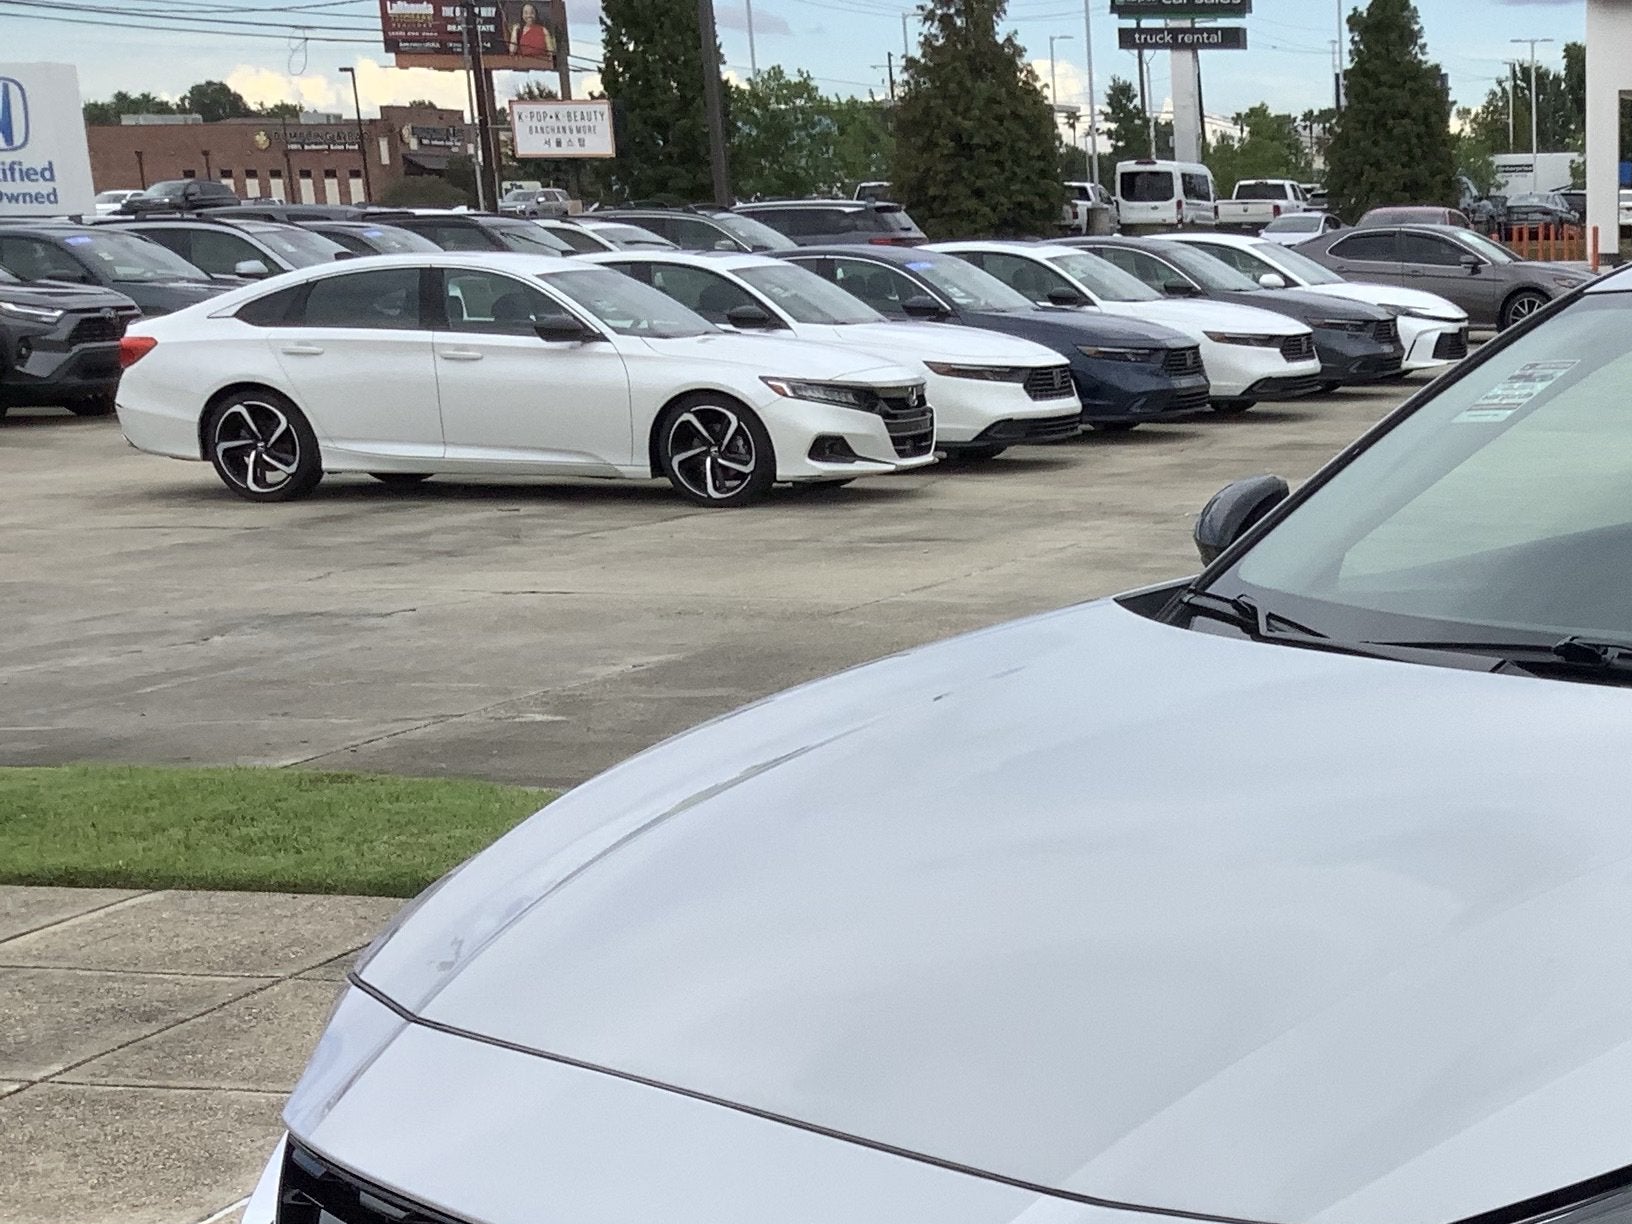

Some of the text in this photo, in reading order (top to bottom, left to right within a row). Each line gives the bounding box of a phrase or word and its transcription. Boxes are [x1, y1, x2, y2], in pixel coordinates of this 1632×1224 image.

[1134, 30, 1222, 44] truck rental
[0, 160, 55, 182] ified
[0, 187, 59, 204] wned
